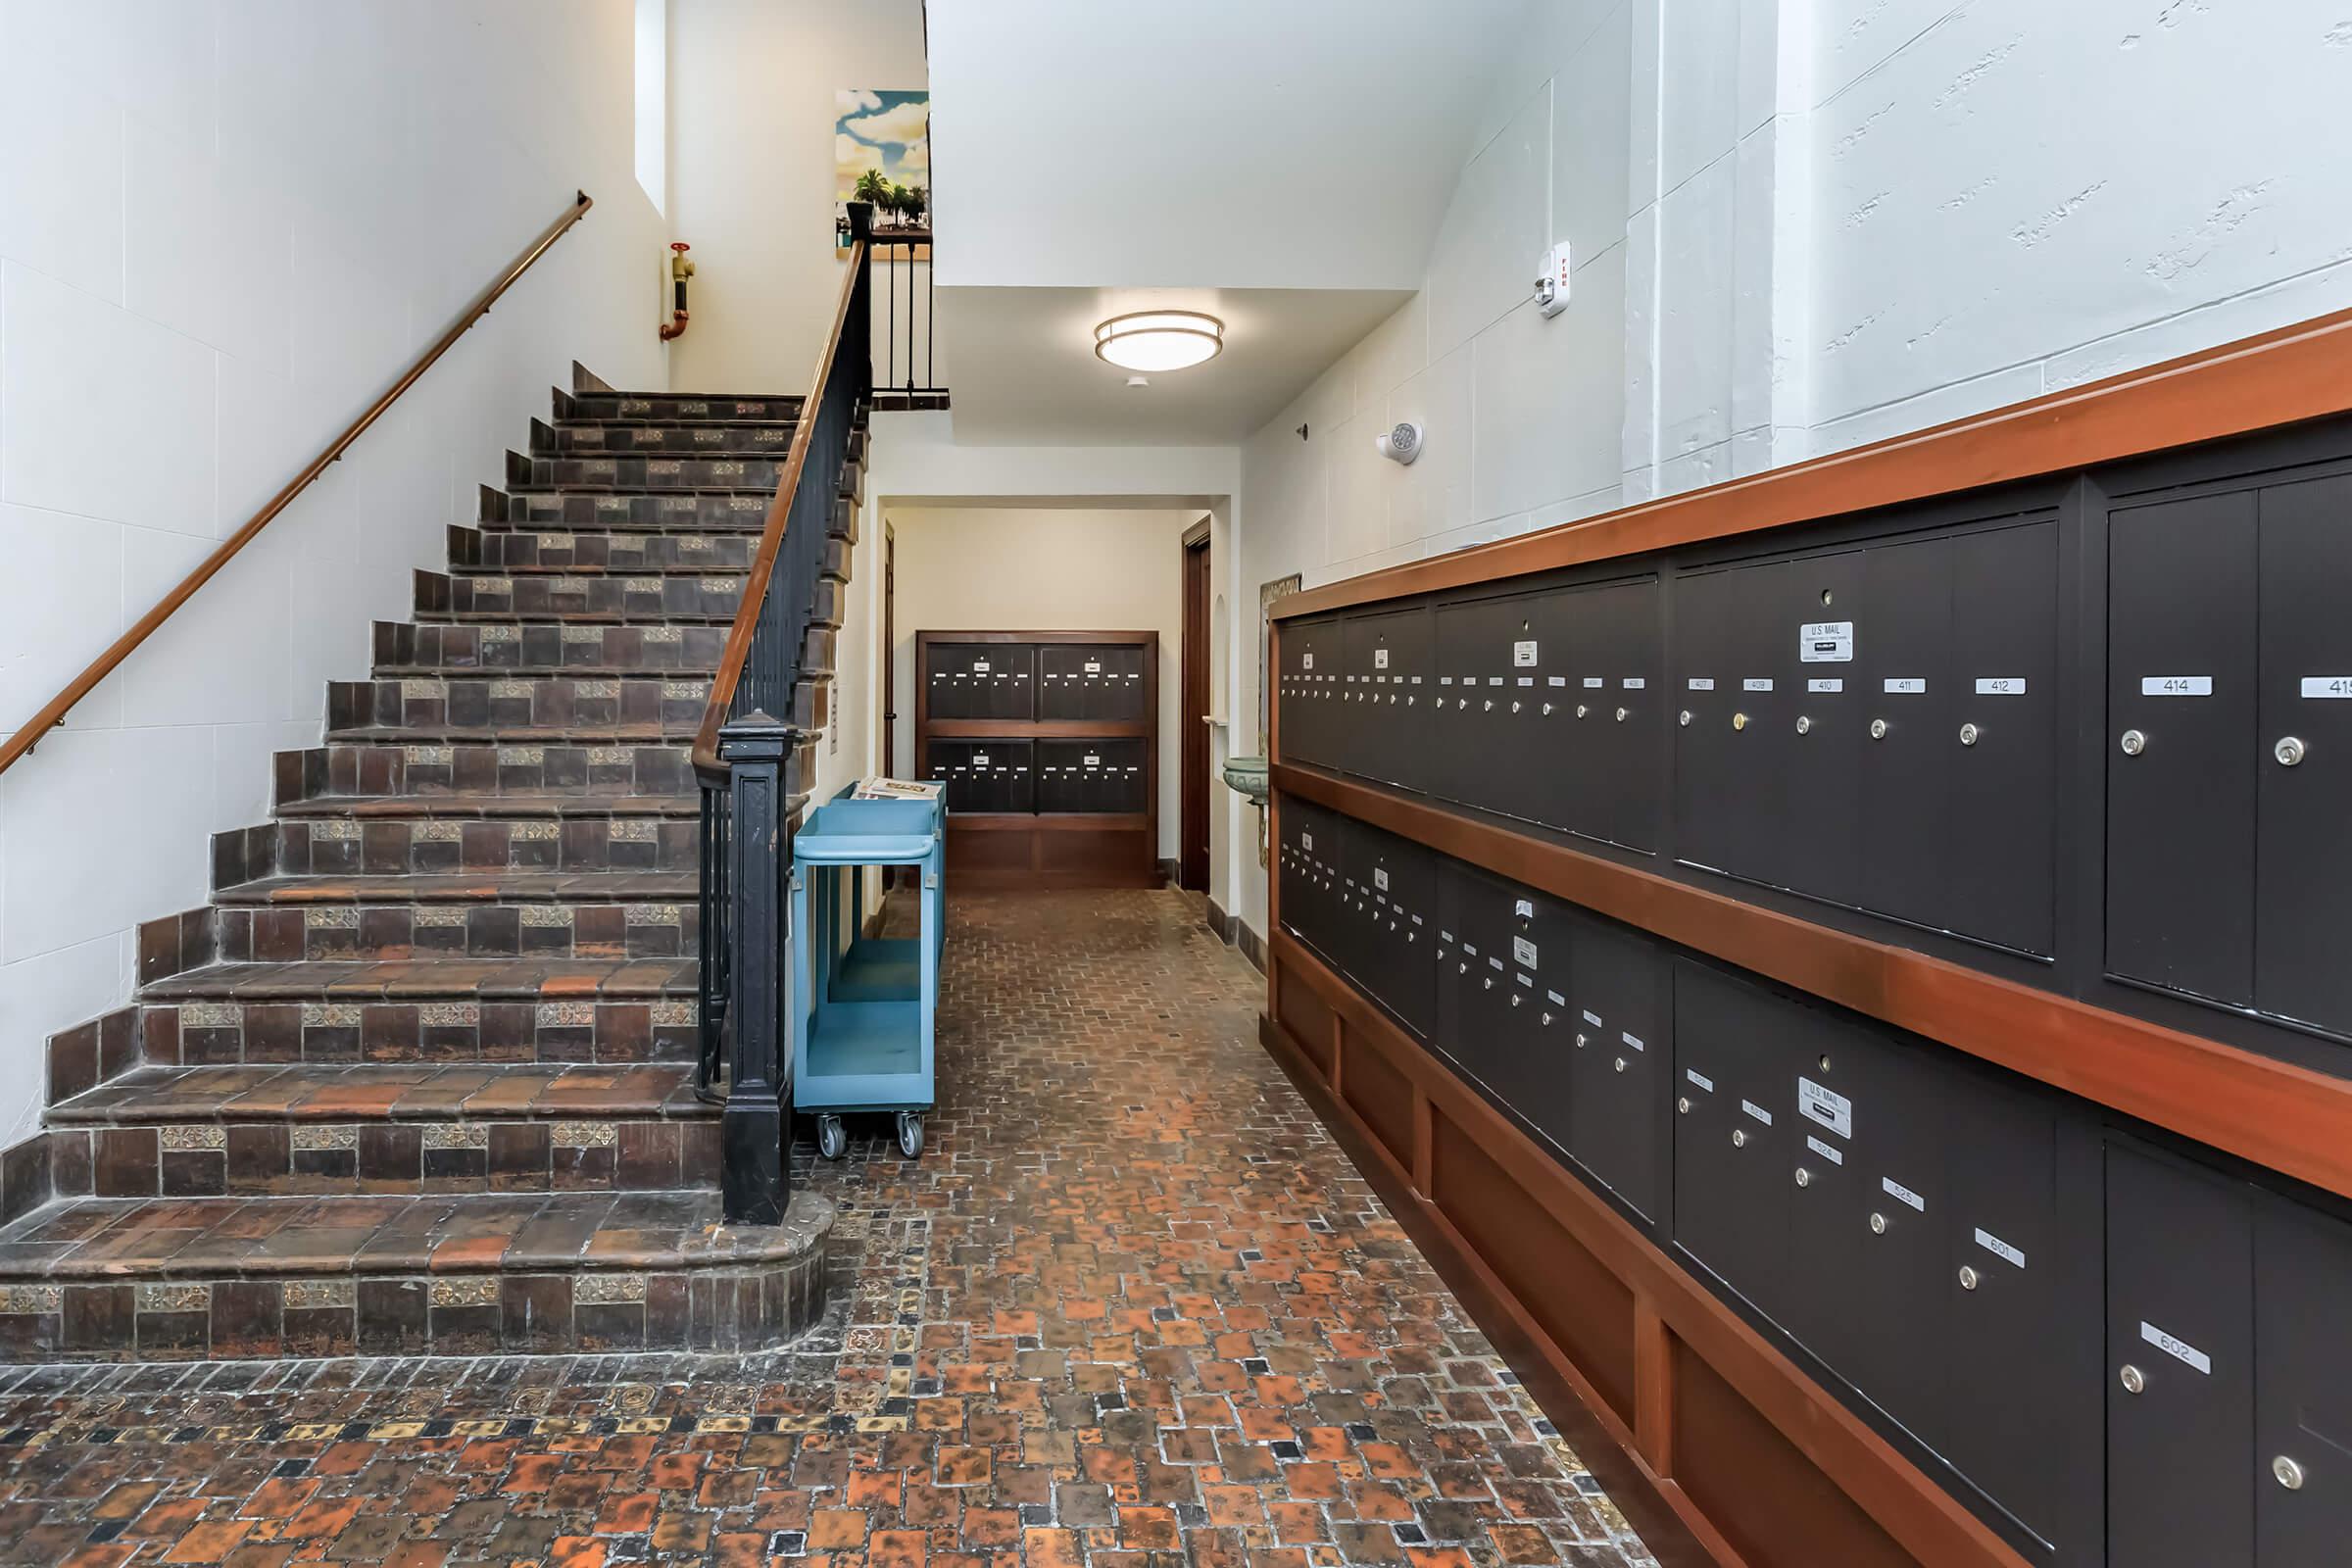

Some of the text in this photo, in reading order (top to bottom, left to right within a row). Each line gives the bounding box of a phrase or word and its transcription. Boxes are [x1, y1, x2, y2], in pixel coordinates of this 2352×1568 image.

[1824, 624, 1840, 635] MAIL
[1818, 680, 1832, 691] 410
[1898, 681, 1911, 691] 411
[1991, 680, 2009, 692] 412
[2163, 680, 2188, 692] 414
[1823, 1090, 1838, 1106] MAIL
[1816, 1142, 1833, 1157] 524
[1894, 1185, 1912, 1202] 525
[1990, 1239, 2010, 1257] 601
[2160, 1335, 2190, 1361] 602
